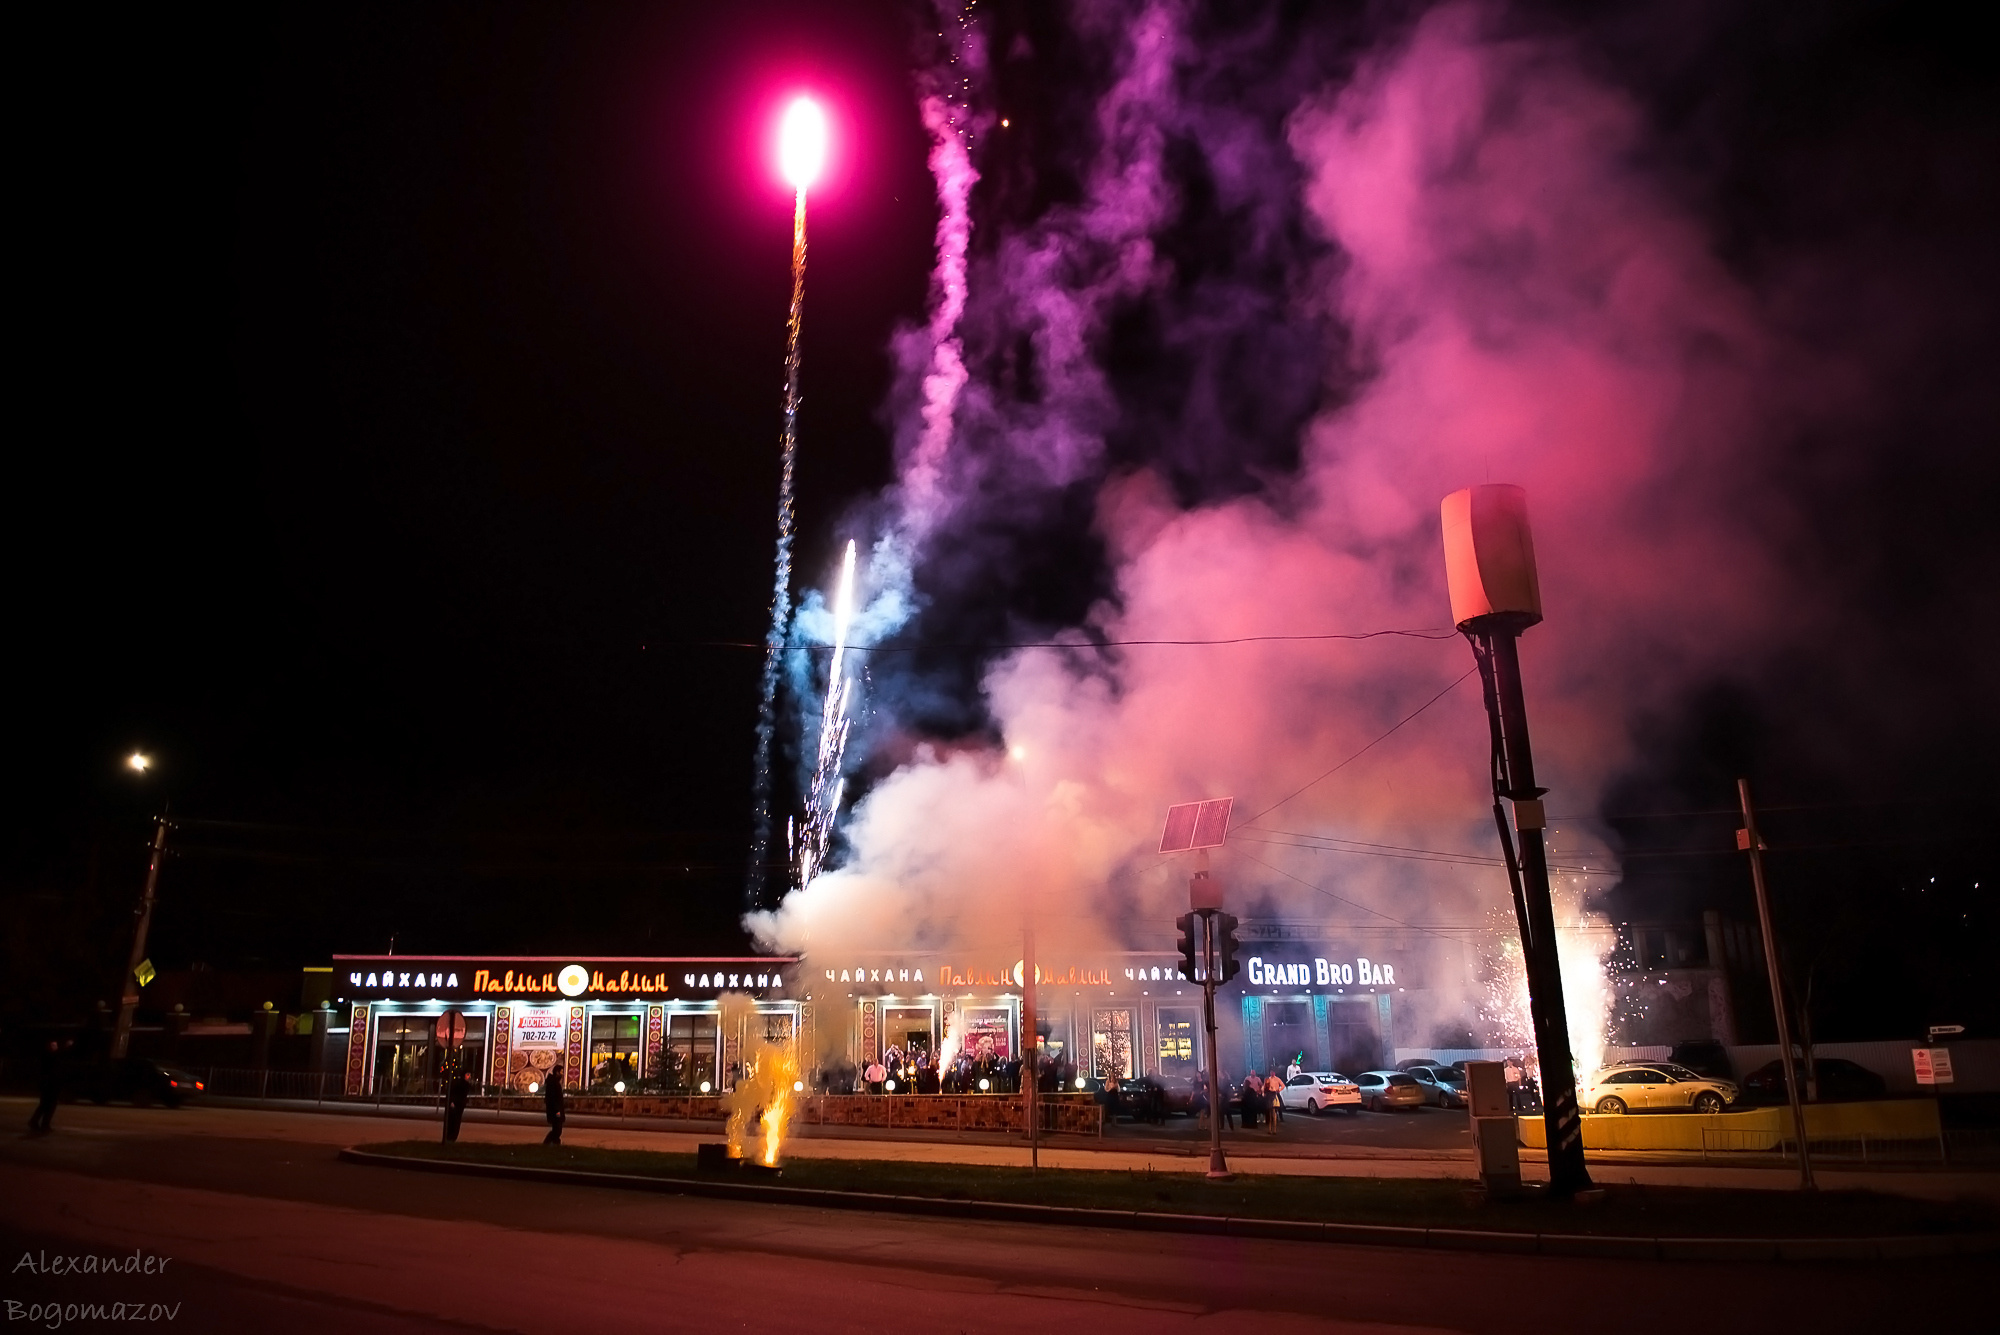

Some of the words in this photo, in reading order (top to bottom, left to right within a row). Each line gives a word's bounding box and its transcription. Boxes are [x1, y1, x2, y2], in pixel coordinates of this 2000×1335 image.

[349, 971, 459, 988] ЧАЙХАНА
[473, 969, 557, 993] Павлин
[684, 971, 783, 988] ЧАЙХАНА
[825, 967, 924, 983] ЧАЙХАНА
[939, 965, 1013, 987] Павлин
[522, 1031, 557, 1041] 702-72-72
